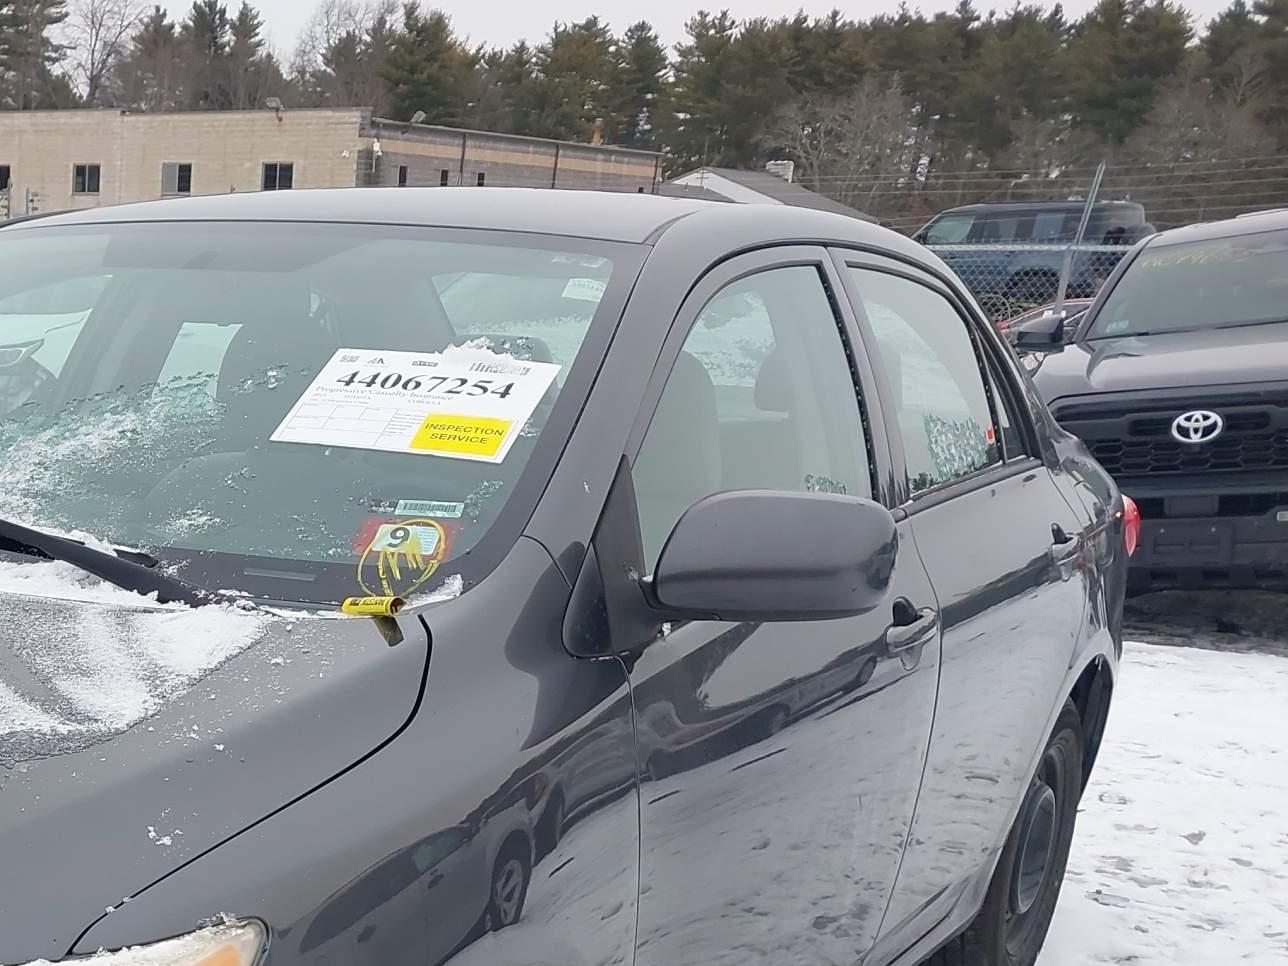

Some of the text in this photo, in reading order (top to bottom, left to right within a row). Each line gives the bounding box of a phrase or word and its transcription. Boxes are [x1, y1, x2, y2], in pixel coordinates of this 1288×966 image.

[336, 370, 515, 399] 44067254
[424, 423, 505, 436] INSPECTION
[429, 432, 489, 445] SERVICE
[386, 526, 411, 548] 9
